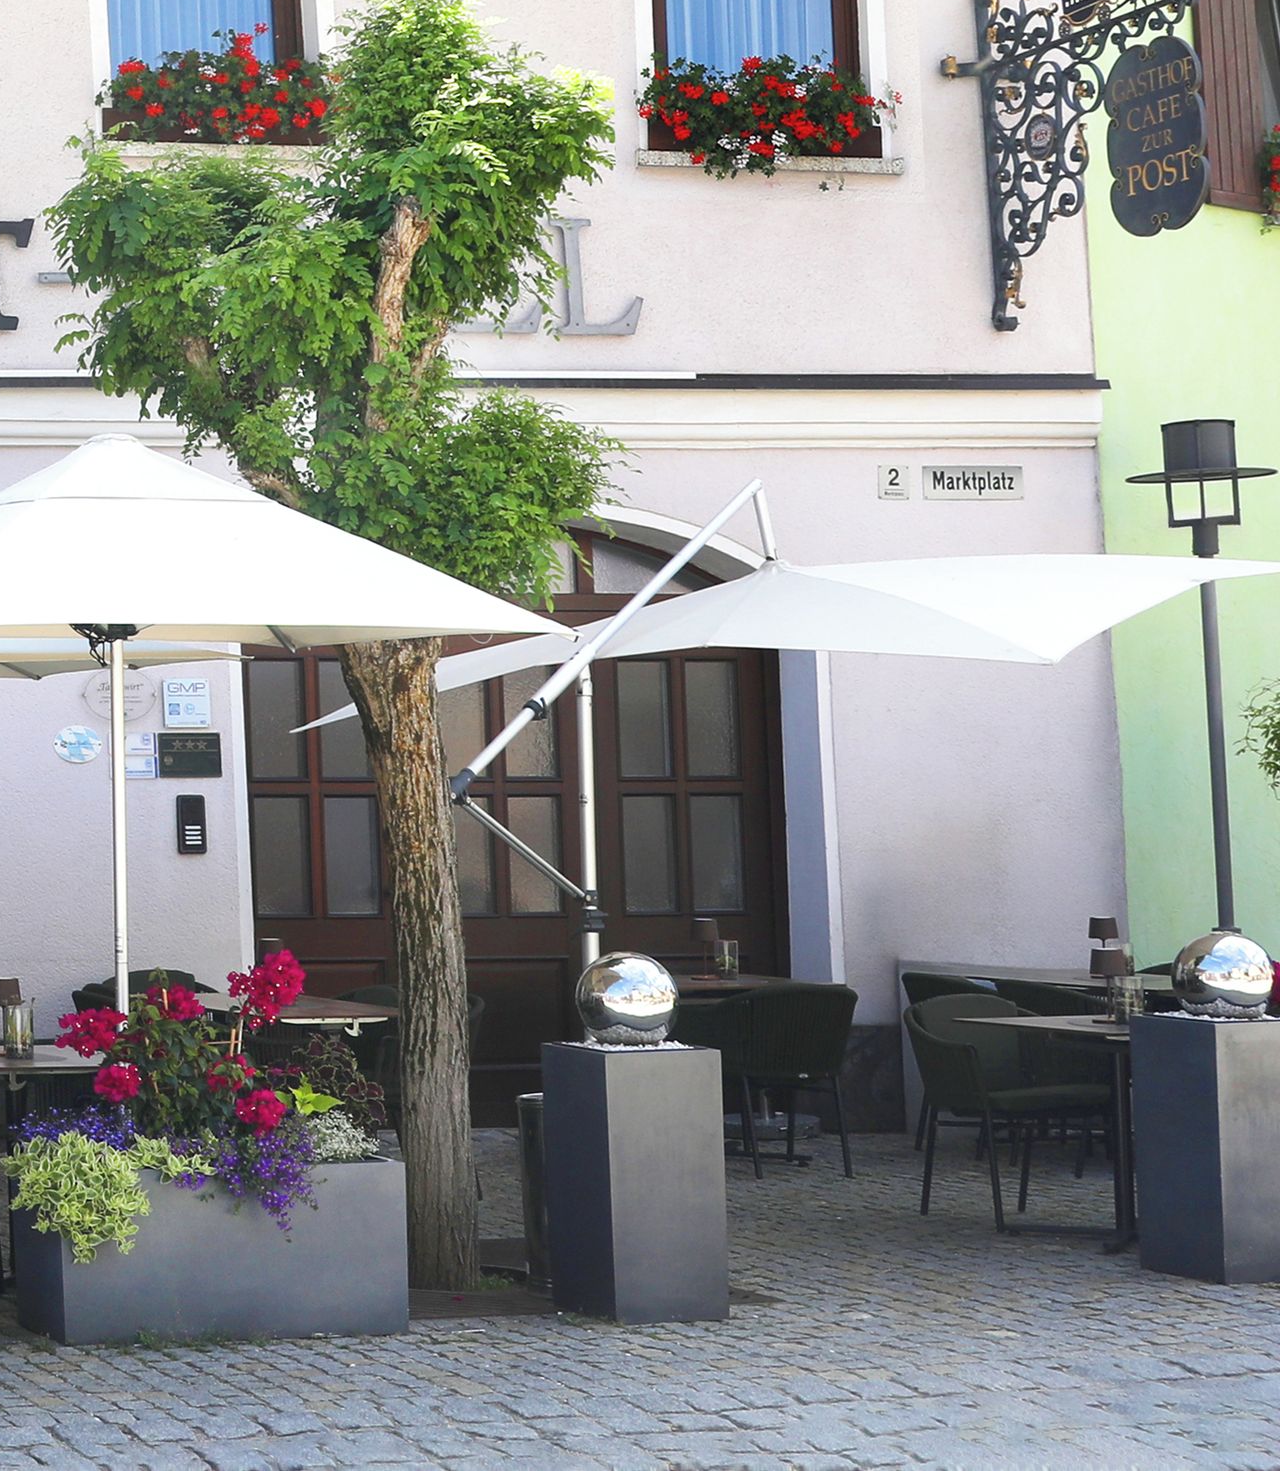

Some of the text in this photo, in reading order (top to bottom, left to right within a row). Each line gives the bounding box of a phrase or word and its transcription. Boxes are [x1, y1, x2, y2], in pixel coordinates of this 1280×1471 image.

[1112, 56, 1193, 103] GASTHOF
[1127, 94, 1182, 132] CAFE
[1141, 128, 1174, 153] ZUR
[1126, 149, 1192, 197] POST
[888, 468, 900, 486] 2
[932, 470, 1015, 495] Marktplatz
[167, 682, 206, 693] GMP
